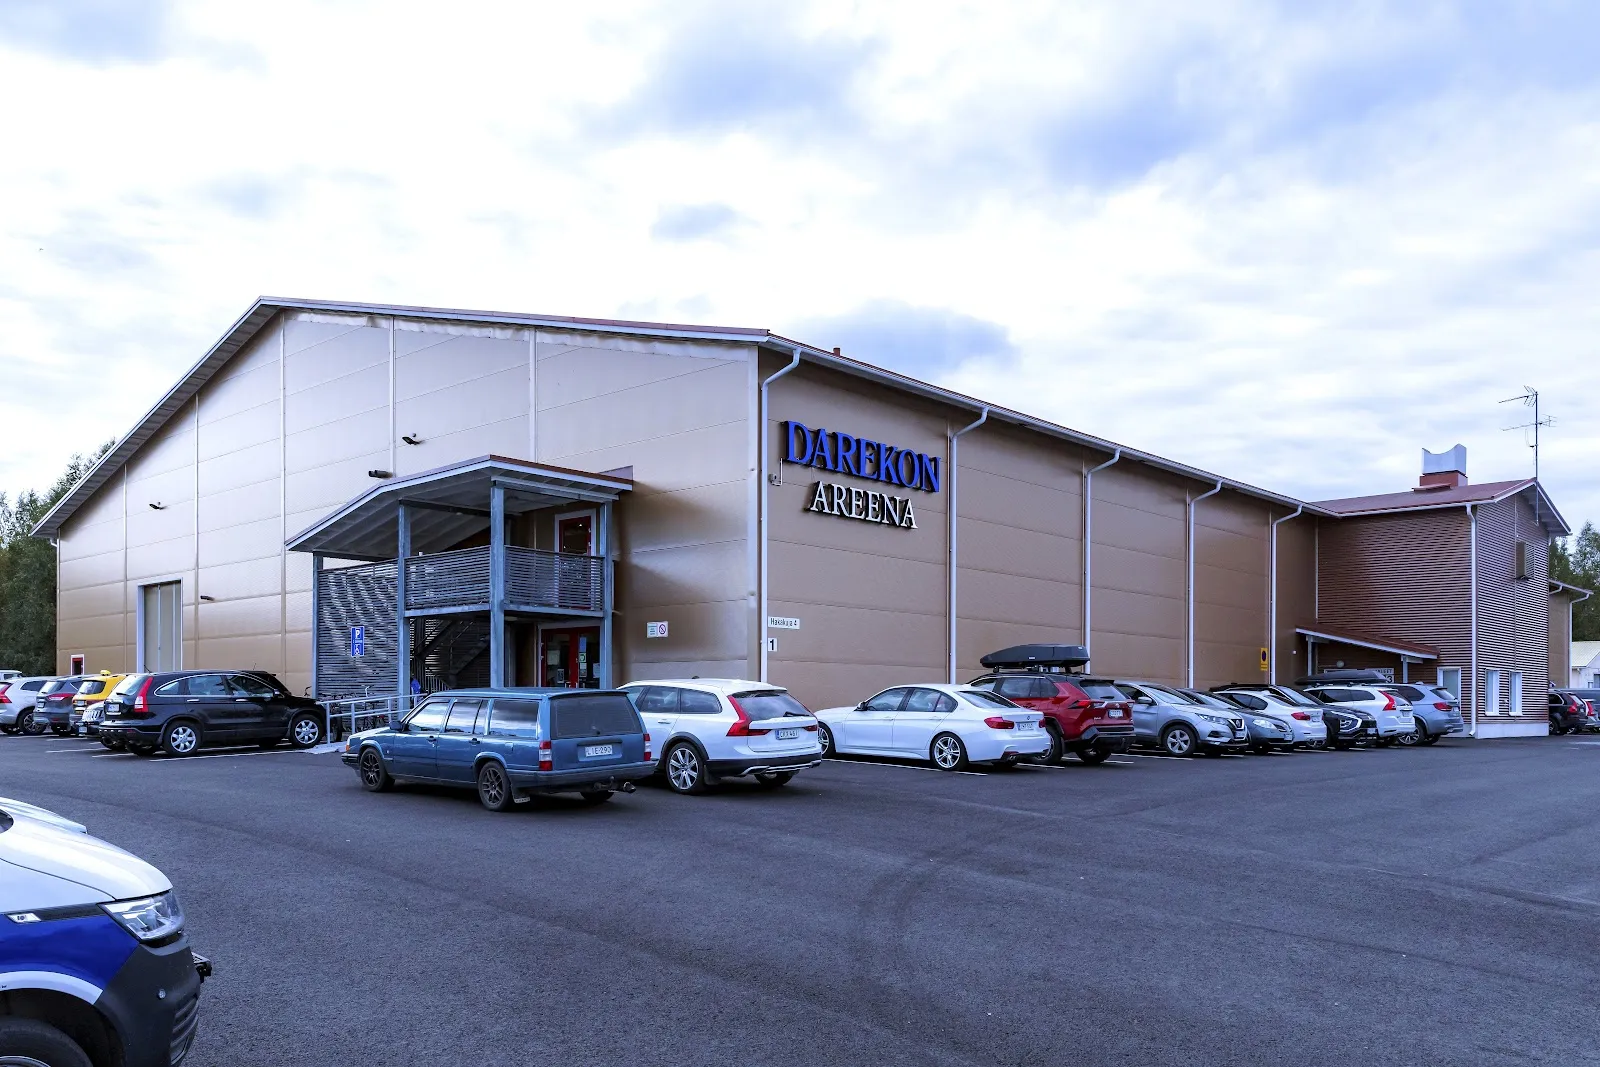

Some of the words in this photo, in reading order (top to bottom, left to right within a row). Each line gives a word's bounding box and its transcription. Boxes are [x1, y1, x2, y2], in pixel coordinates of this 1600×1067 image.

[784, 420, 941, 493] DAREKON
[808, 480, 919, 529] AREENA
[769, 638, 775, 651] 1
